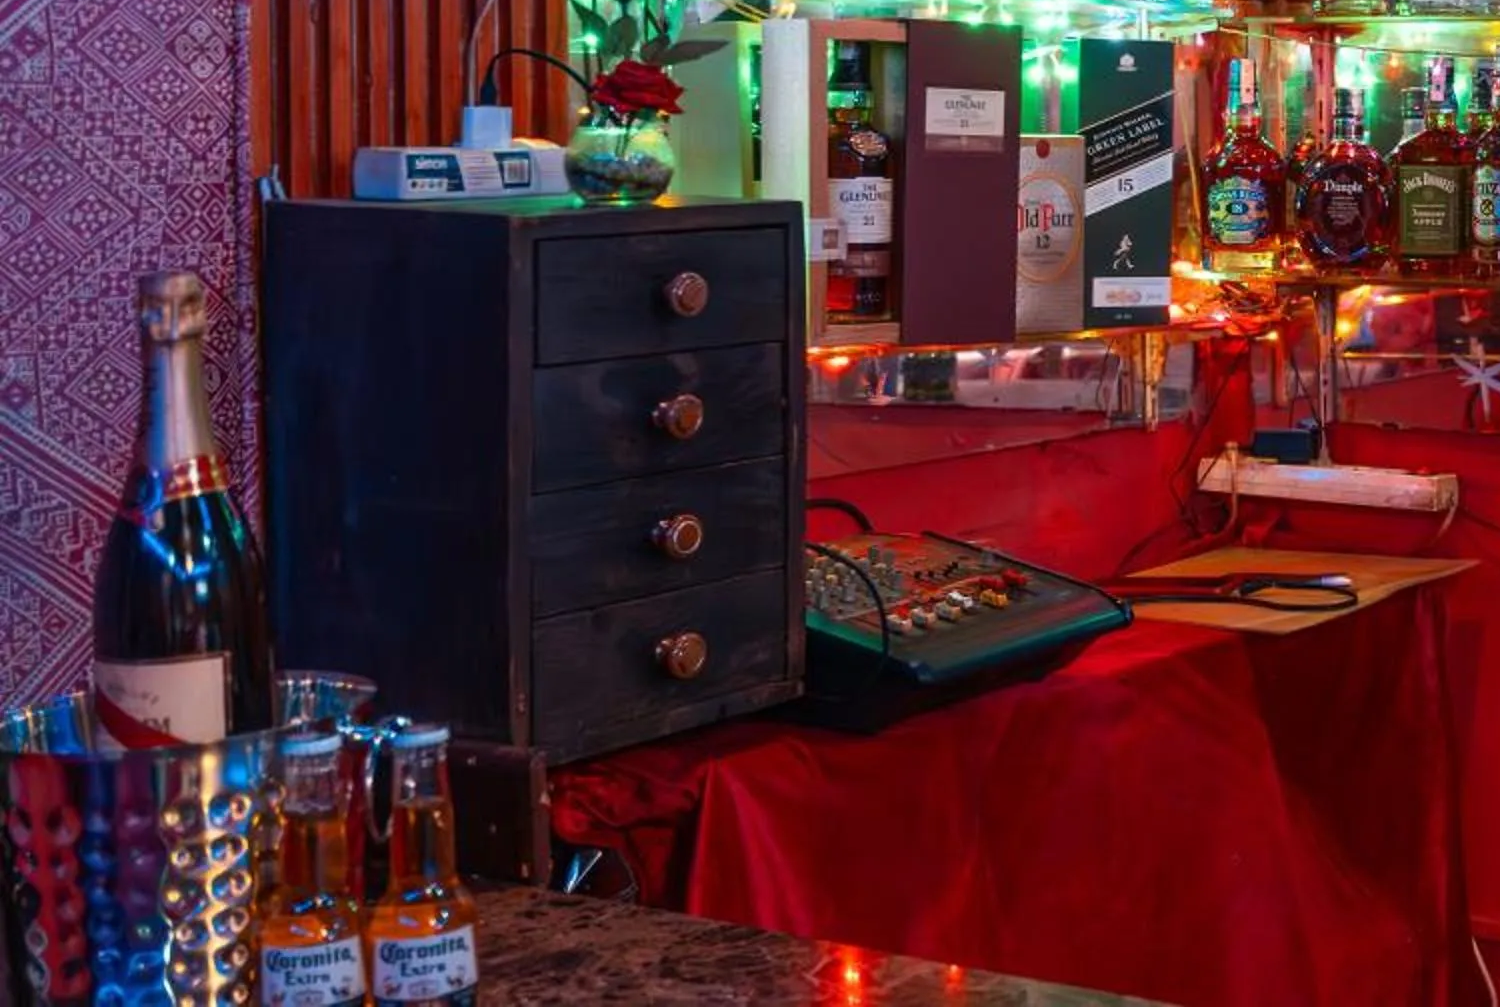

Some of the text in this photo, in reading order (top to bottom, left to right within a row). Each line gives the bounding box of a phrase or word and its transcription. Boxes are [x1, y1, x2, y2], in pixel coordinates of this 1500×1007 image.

[1127, 117, 1165, 139] LABEL
[1118, 178, 1135, 192] 15
[1036, 234, 1051, 250] 12
[380, 936, 467, 965] Coronita
[266, 946, 352, 973] Coronita
[400, 962, 446, 978] Extra
[284, 971, 330, 987] Extra
